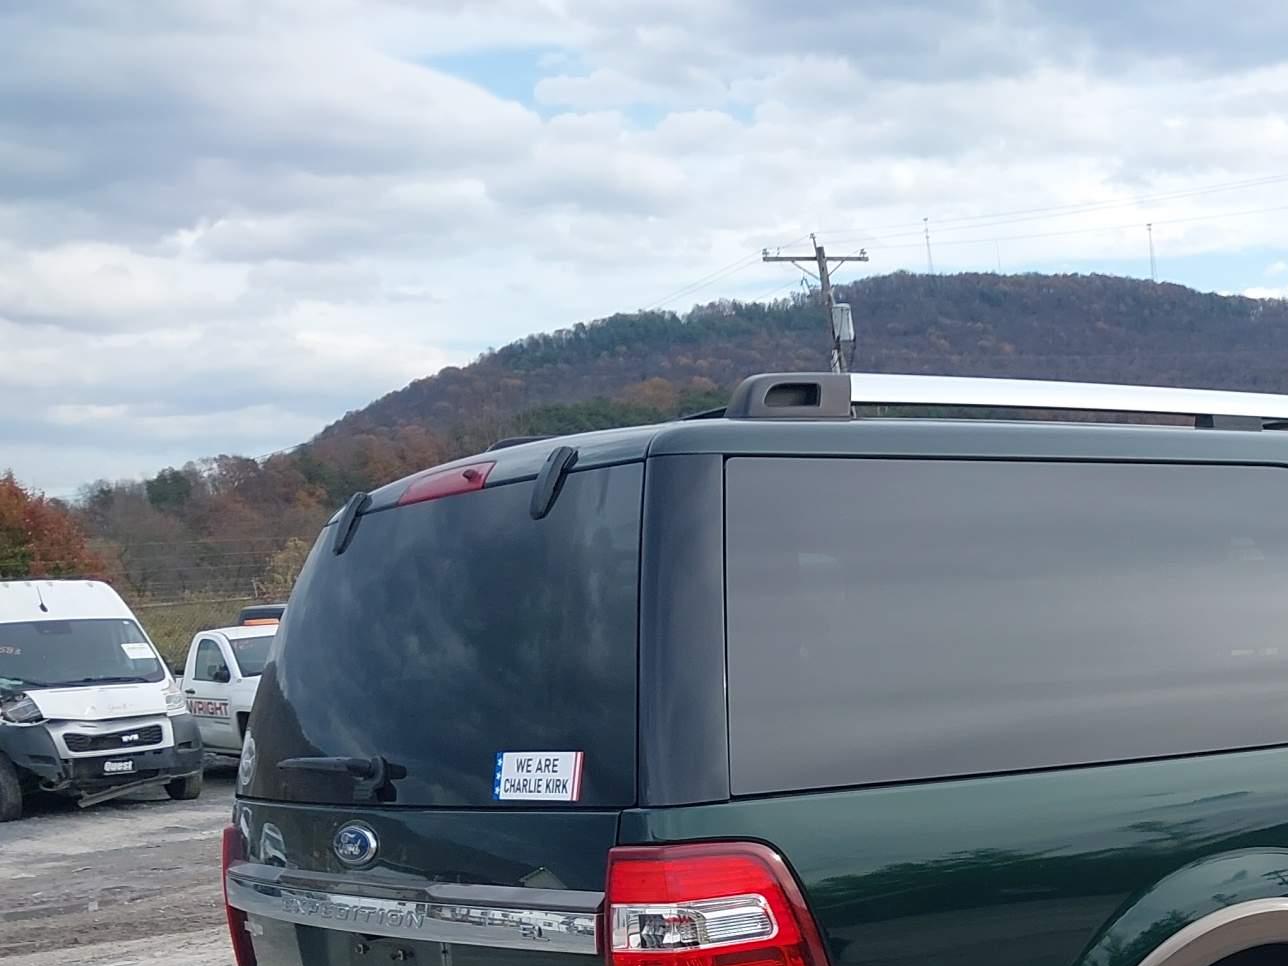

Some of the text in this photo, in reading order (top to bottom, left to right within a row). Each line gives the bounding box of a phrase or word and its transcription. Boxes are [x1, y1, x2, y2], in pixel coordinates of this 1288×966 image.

[515, 758, 560, 774] WE ARE
[503, 778, 569, 794] CHARLIE KIRK
[281, 898, 427, 929] EXPEDITION
